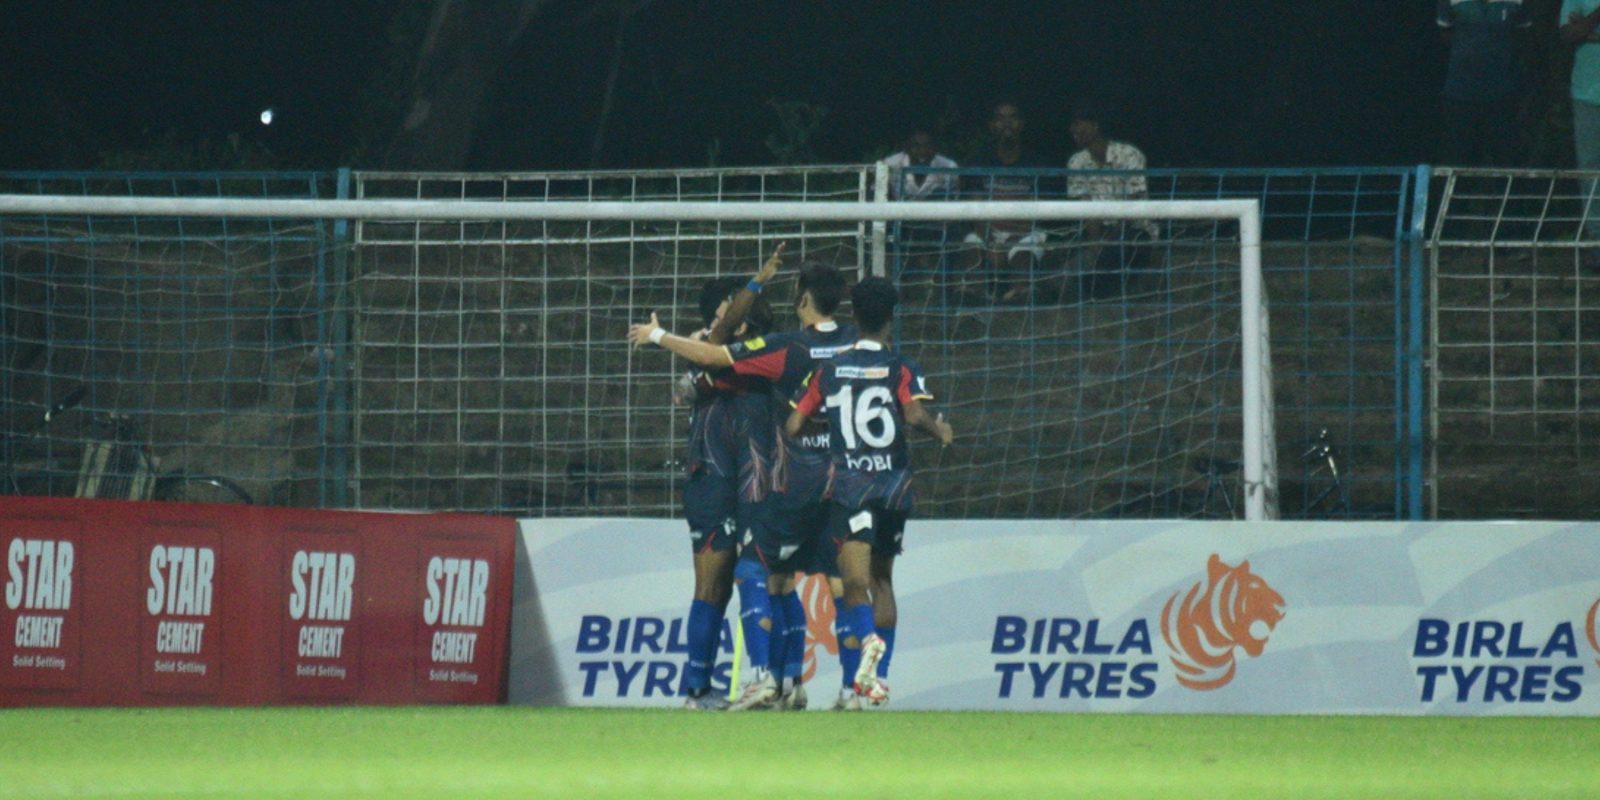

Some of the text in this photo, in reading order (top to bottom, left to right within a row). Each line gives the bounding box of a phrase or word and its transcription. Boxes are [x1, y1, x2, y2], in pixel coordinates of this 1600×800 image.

[825, 384, 896, 448] 16
[5, 538, 74, 610] STAR
[146, 544, 215, 616] STAR
[289, 550, 355, 621] STAR
[423, 556, 489, 626] STAR
[15, 615, 63, 648] CEMENT
[156, 621, 204, 654] CEMENT
[298, 625, 344, 658] CEMENT
[431, 631, 477, 663] CEMENT
[990, 616, 1153, 654] BIRLA
[1413, 619, 1578, 658] BIRLA
[13, 655, 65, 670] Solid Setting
[154, 660, 206, 675] Solid Setting
[296, 664, 346, 679] Solid Setting
[429, 669, 478, 684] Solid Setting
[994, 662, 1159, 699] TYRES
[1416, 666, 1584, 703] TYRES
